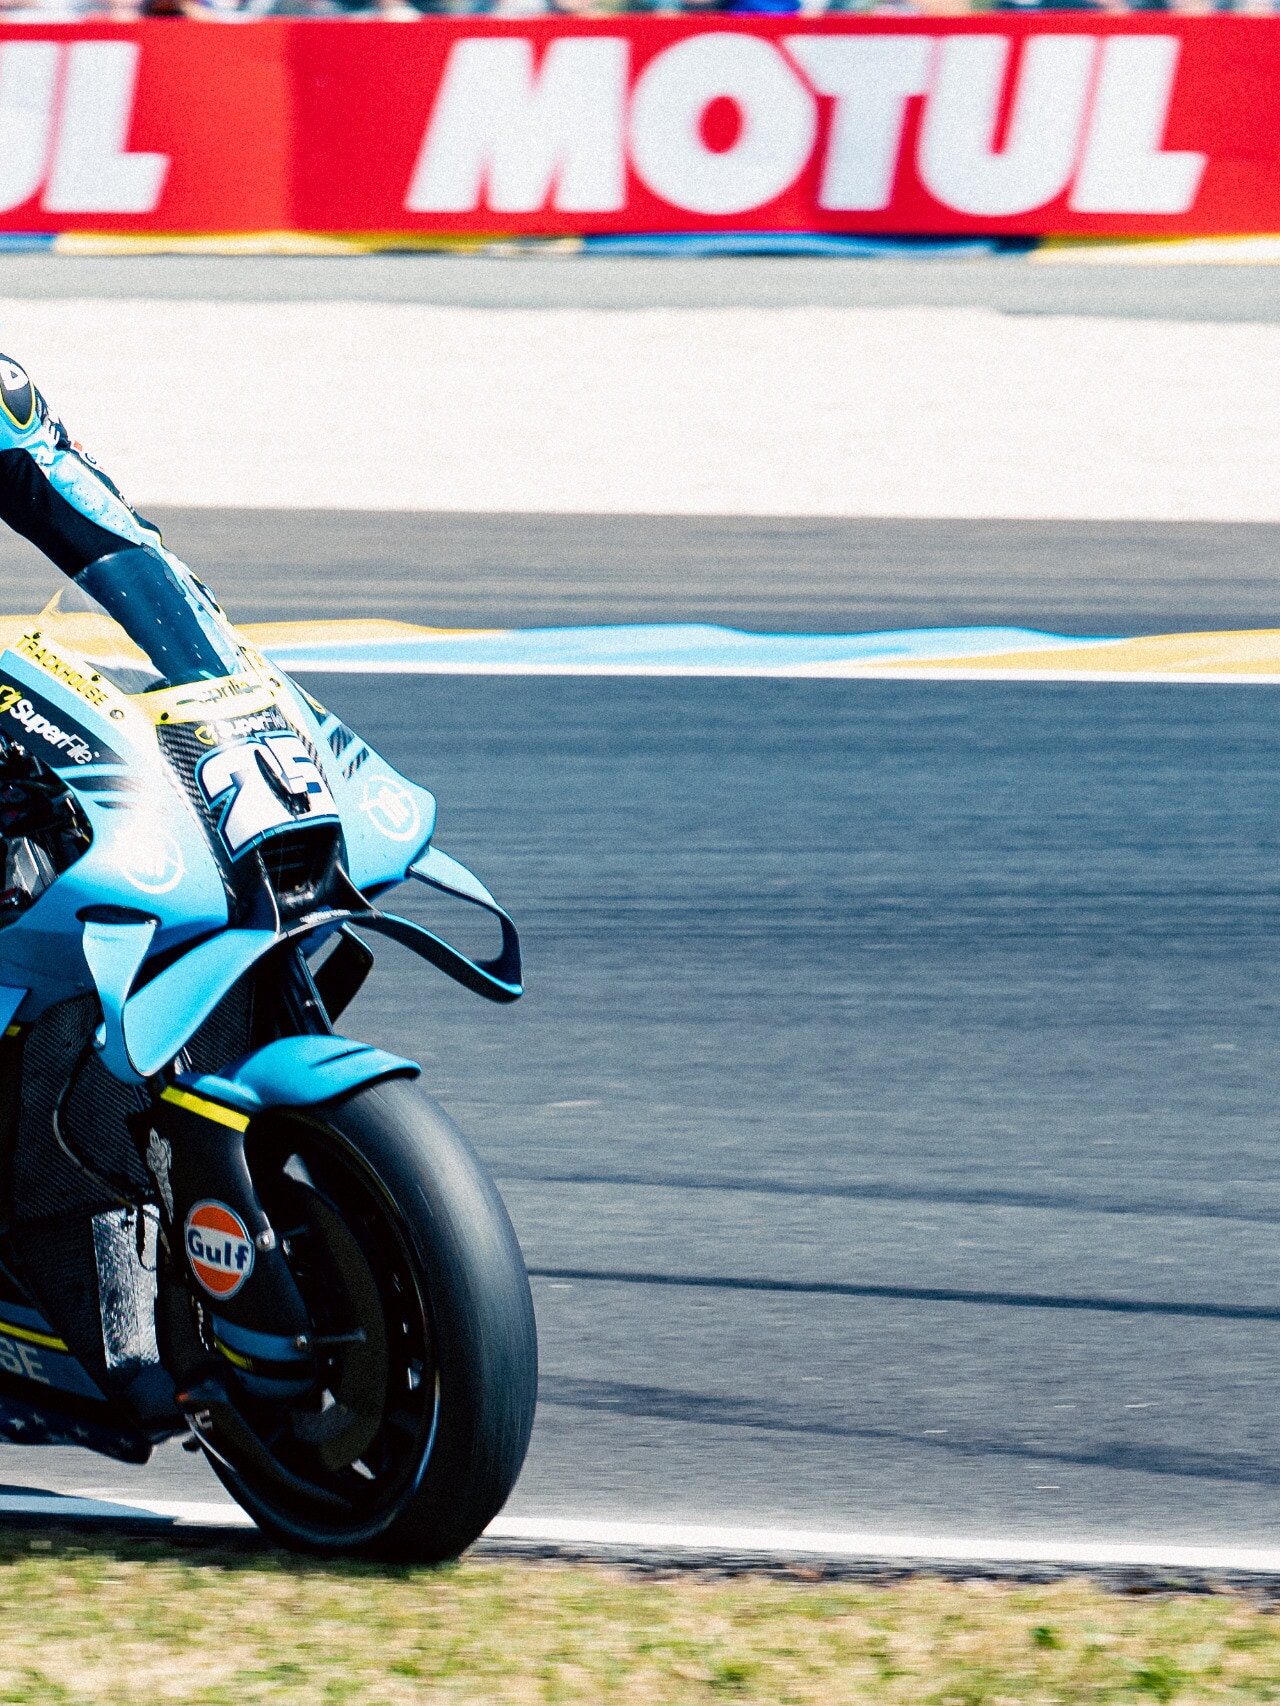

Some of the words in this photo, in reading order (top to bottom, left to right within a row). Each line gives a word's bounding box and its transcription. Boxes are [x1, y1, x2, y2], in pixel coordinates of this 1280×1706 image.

[404, 32, 1208, 217] MOTUL
[197, 732, 341, 857] 25
[187, 1227, 249, 1271] Gulf
